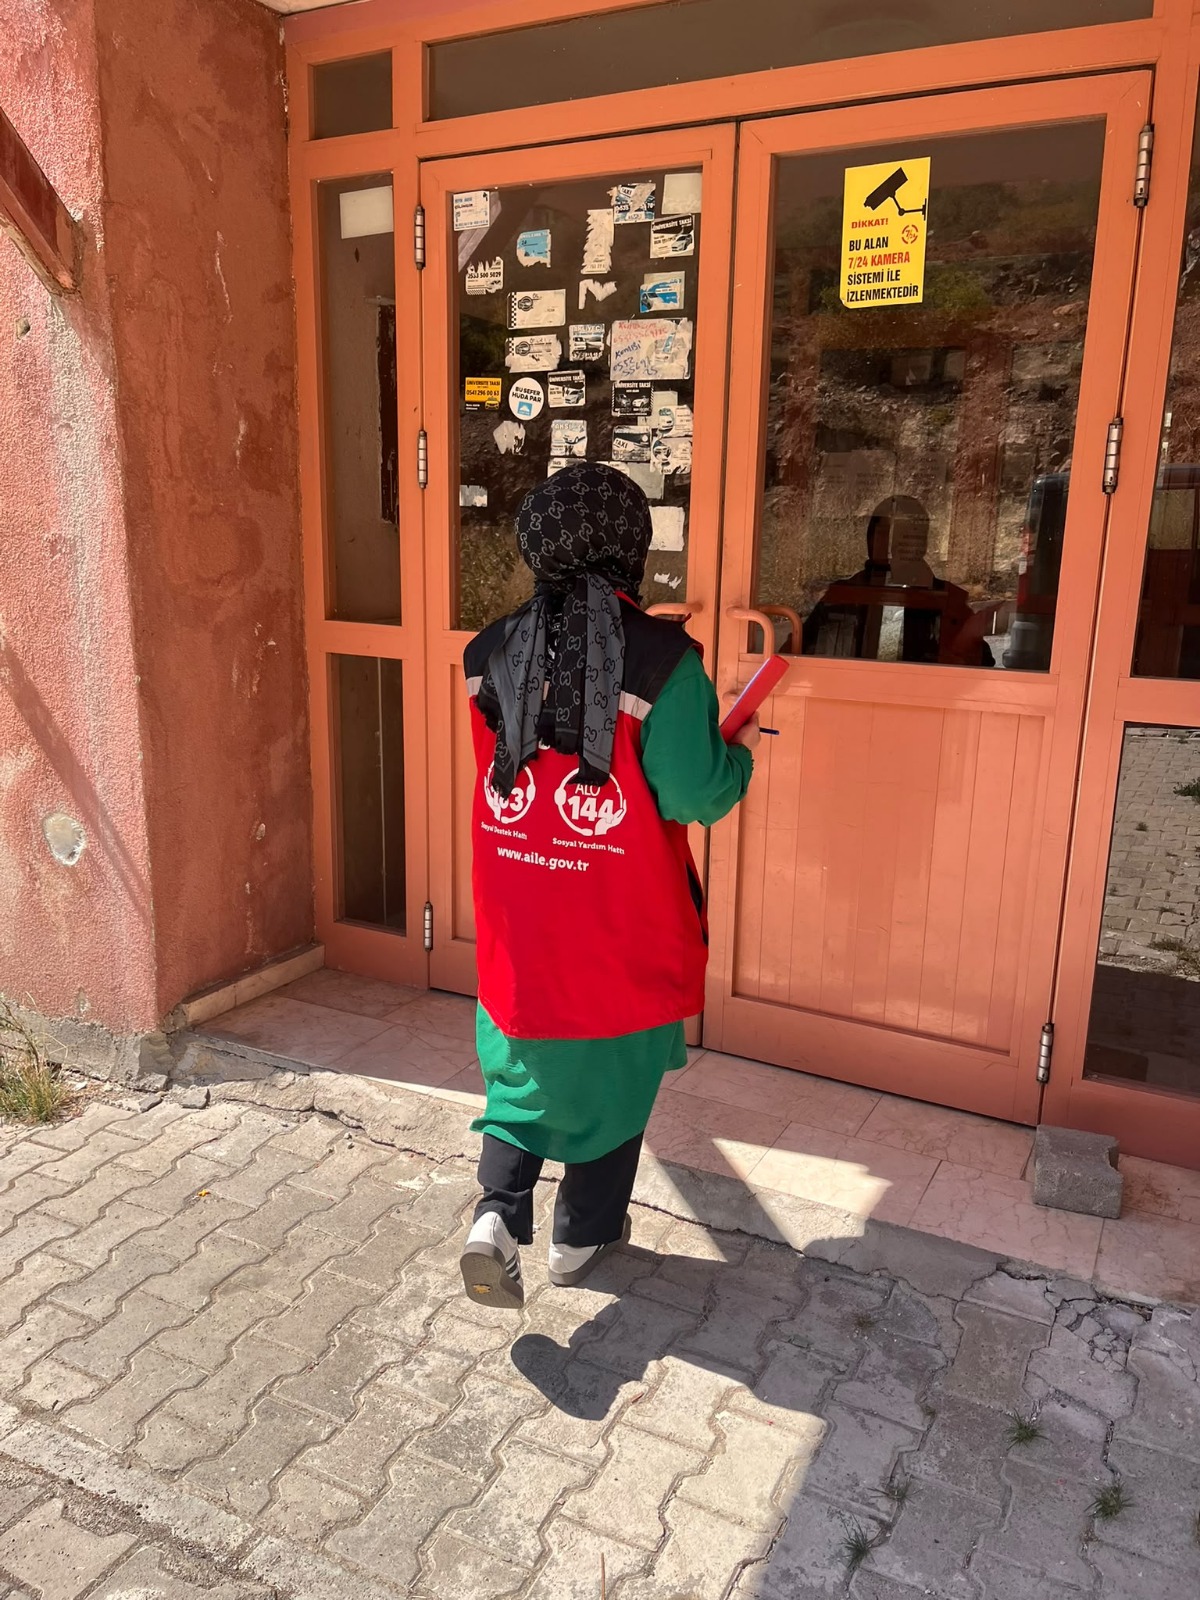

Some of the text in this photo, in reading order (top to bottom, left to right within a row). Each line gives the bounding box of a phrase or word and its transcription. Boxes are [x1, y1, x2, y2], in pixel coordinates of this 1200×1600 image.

[851, 218, 889, 229] DİKKAT!
[849, 236, 889, 252] BU ALAN
[848, 251, 910, 269] 7/24 KAMERA
[847, 268, 901, 286] SİSTEMİ İLE
[846, 283, 919, 303] İZLENMEKTEDİR
[523, 388, 541, 396] SEFER
[529, 395, 542, 403] PAR
[615, 439, 628, 449] TAXI
[568, 796, 614, 823] 144
[493, 825, 512, 836] Destek
[552, 837, 625, 855] Sosyal Yardım Hattı
[497, 847, 589, 872] www.aile.gov.tr
